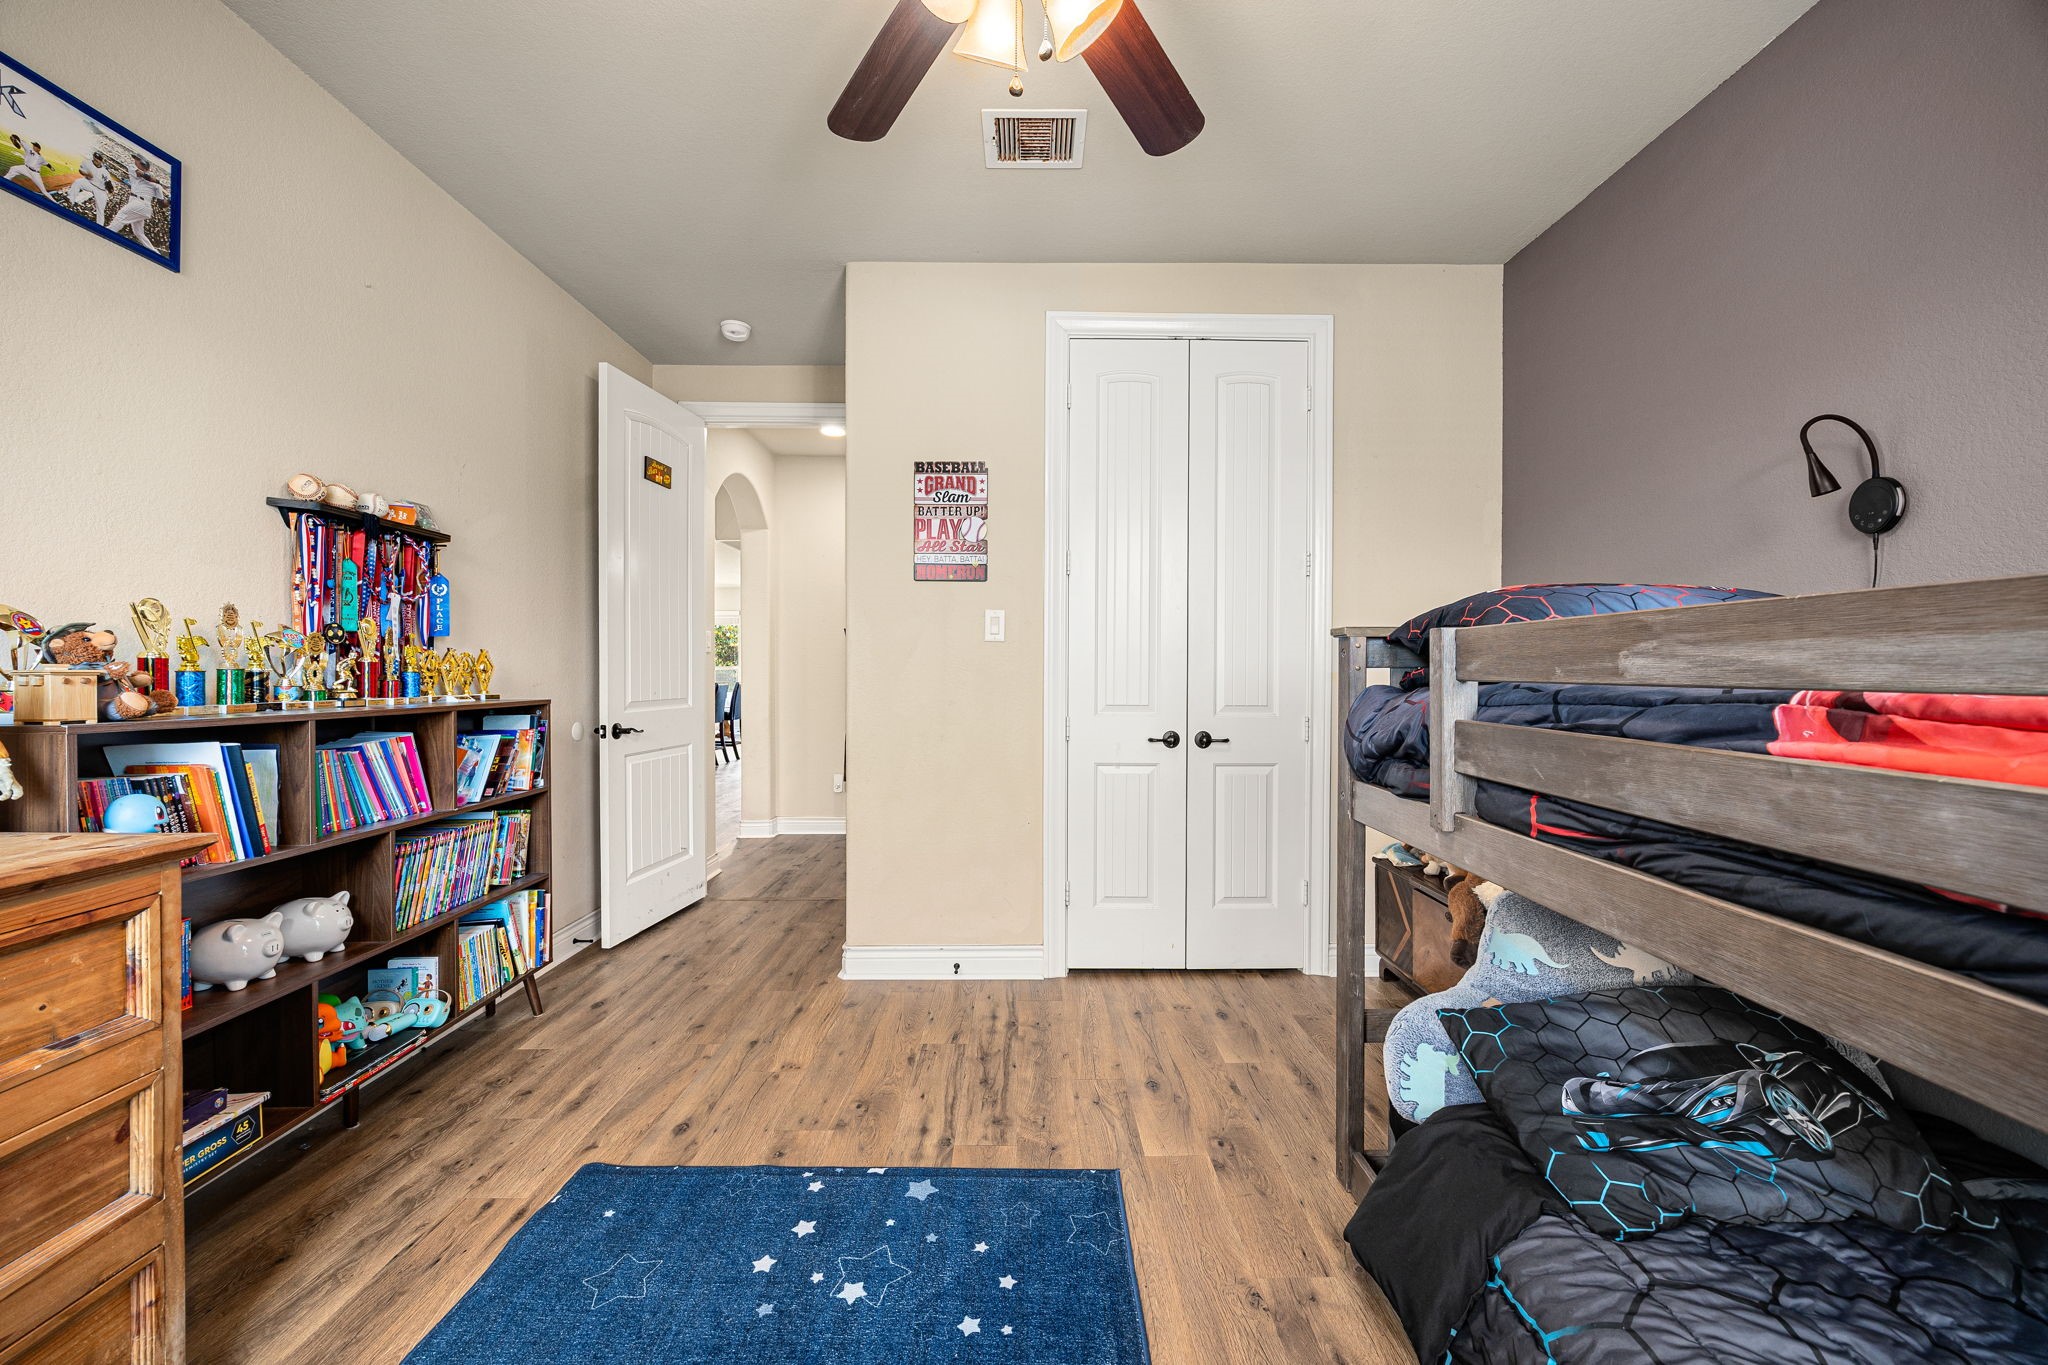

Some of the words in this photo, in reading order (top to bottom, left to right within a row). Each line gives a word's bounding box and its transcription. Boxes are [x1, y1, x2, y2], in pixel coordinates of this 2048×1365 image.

[914, 461, 988, 474] BASEBALL
[924, 475, 977, 496] GRAND
[933, 490, 972, 503] Slam
[918, 506, 962, 516] BATTER
[966, 506, 984, 516] UP!
[915, 518, 963, 540] PLAY
[917, 540, 947, 552] All
[949, 540, 985, 553] Star
[236, 1120, 249, 1134] 45
[197, 1136, 228, 1158] GROSS
